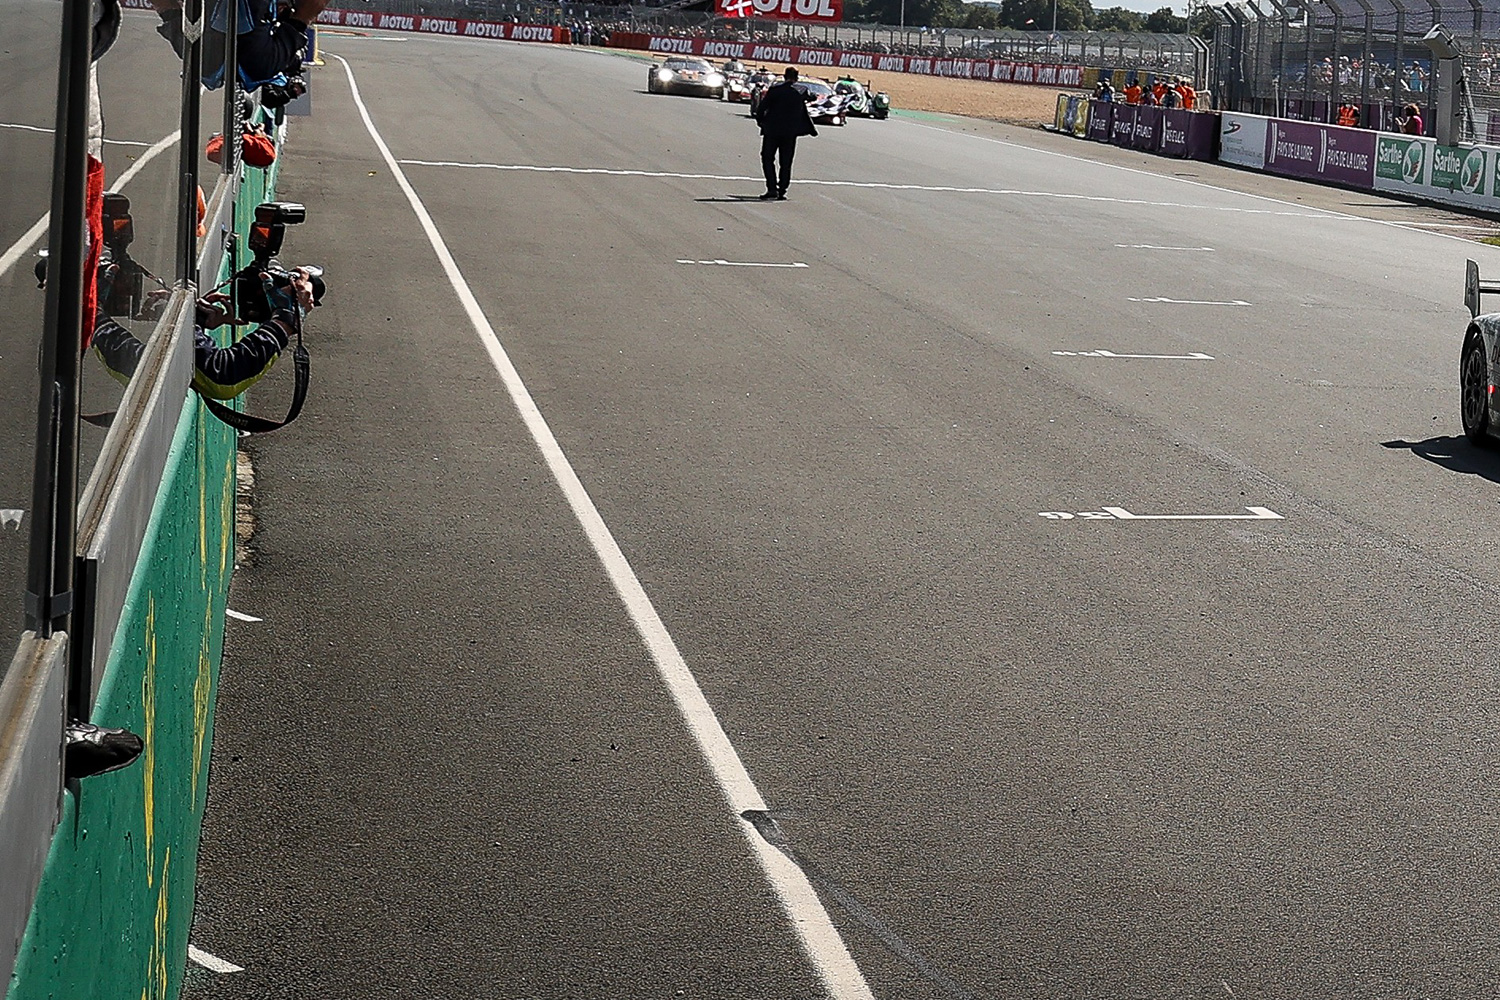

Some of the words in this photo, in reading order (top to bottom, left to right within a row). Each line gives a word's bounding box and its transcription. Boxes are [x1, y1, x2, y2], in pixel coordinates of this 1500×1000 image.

[345, 13, 374, 27] MOTUL
[379, 16, 414, 30] MOTUL
[419, 18, 458, 34] MOTUL
[464, 22, 505, 38] MOTUL
[511, 24, 553, 41] MOTUL
[649, 36, 693, 53] MOTUL
[702, 41, 744, 57] MOTUL
[752, 45, 791, 62] MOTUL
[797, 49, 834, 65] MOTUL
[839, 53, 873, 69] MOTUL
[877, 57, 905, 72] MOTUL
[908, 59, 931, 74] MOTUL
[1379, 141, 1402, 164] Sarthe
[1434, 148, 1461, 174] Sarthe
